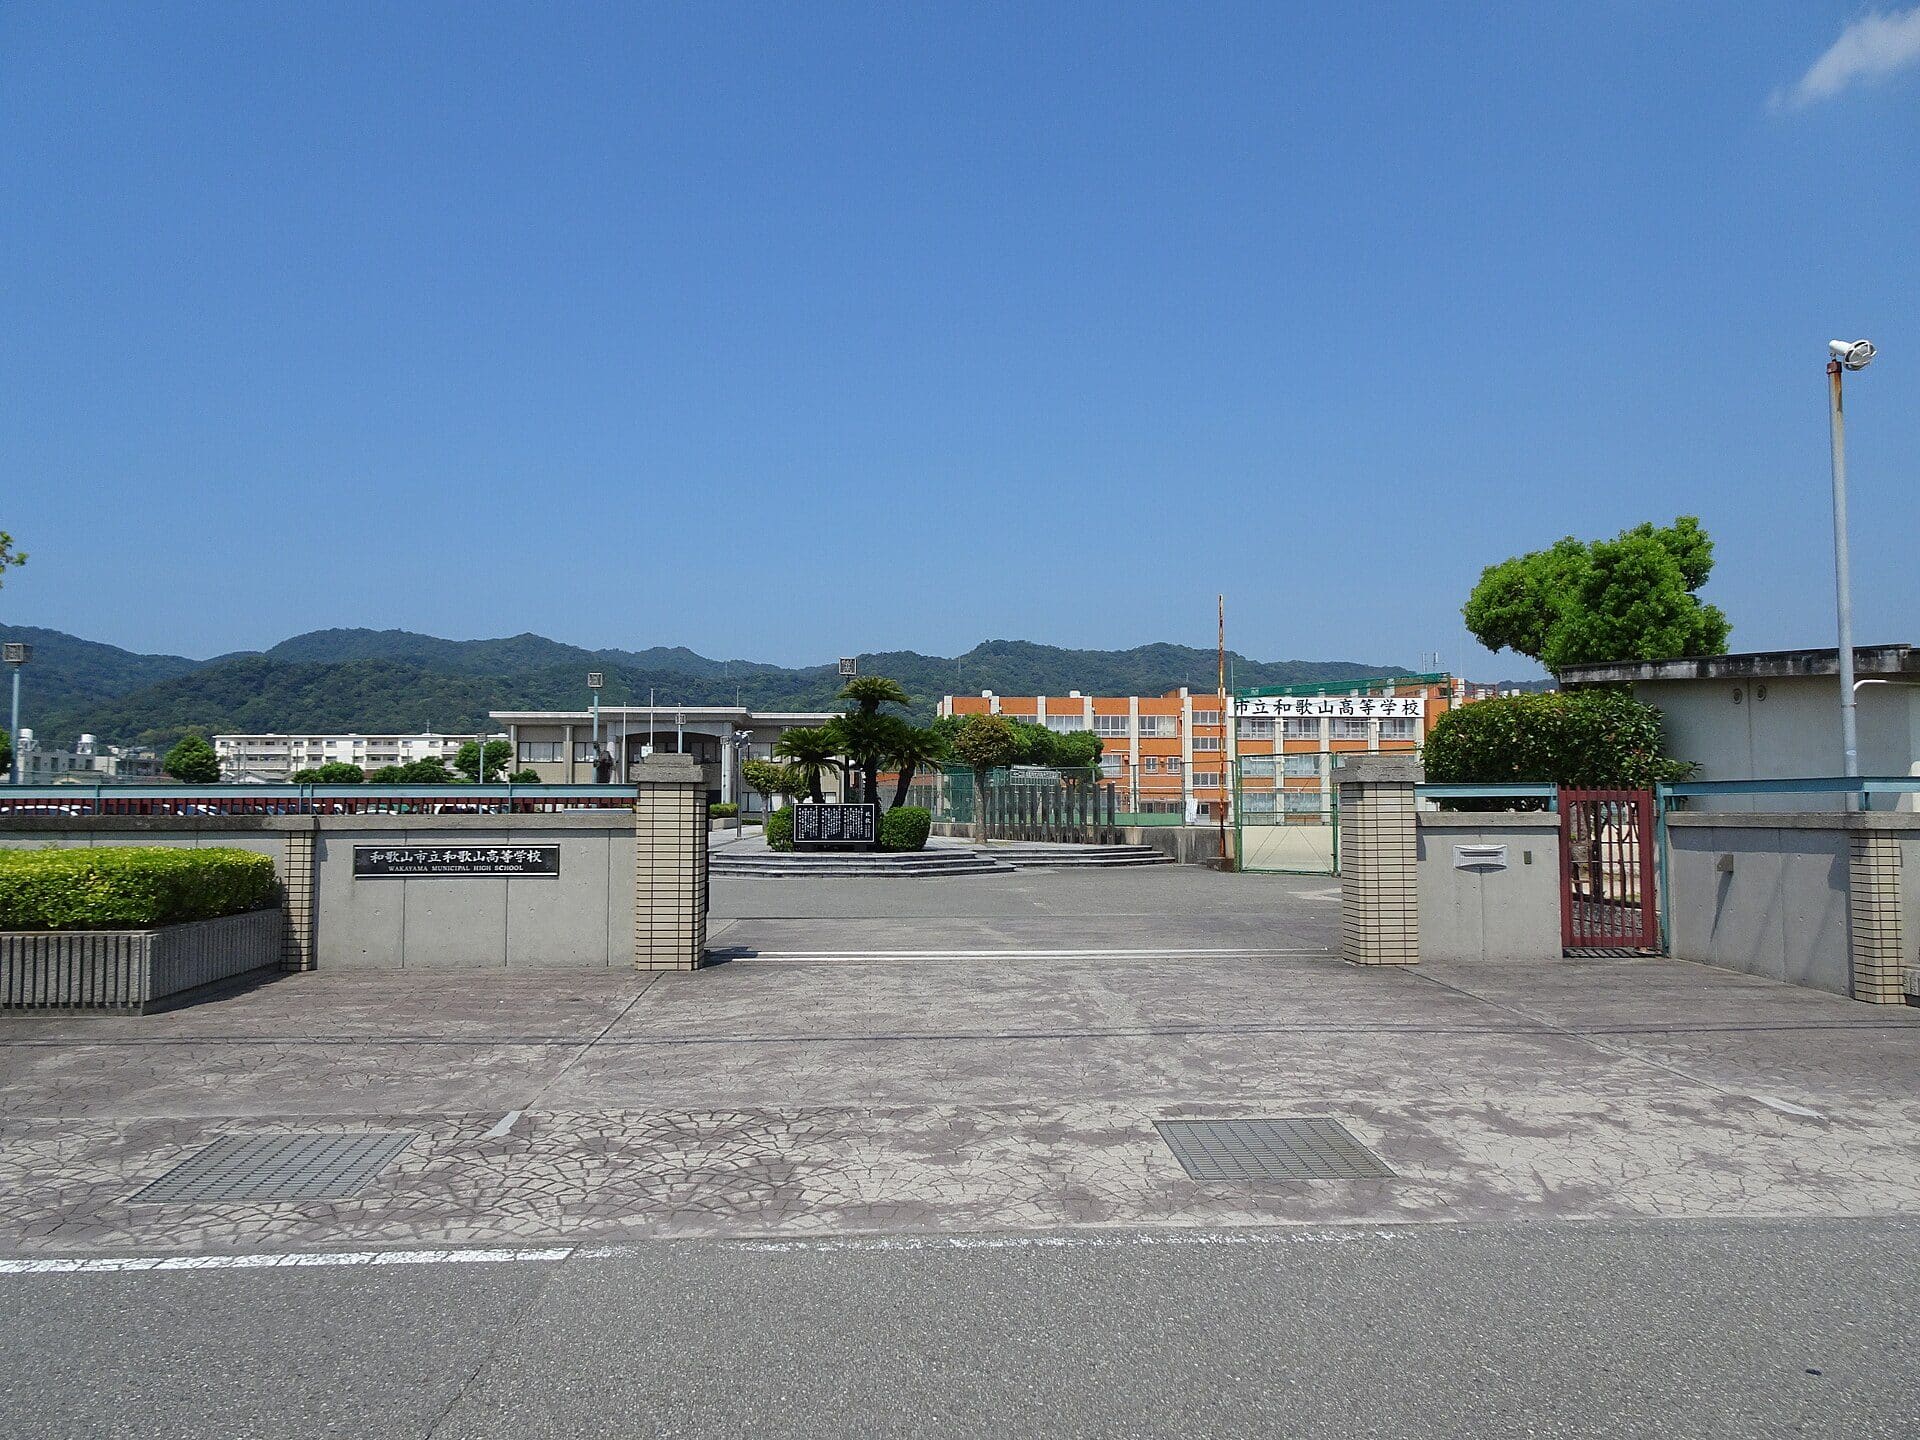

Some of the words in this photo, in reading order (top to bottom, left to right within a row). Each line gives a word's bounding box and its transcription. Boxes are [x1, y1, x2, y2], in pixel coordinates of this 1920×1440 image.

[1234, 698, 1420, 716] 市立和歌山高等学校
[370, 850, 542, 863] 和歌山市立和歌山高等学校
